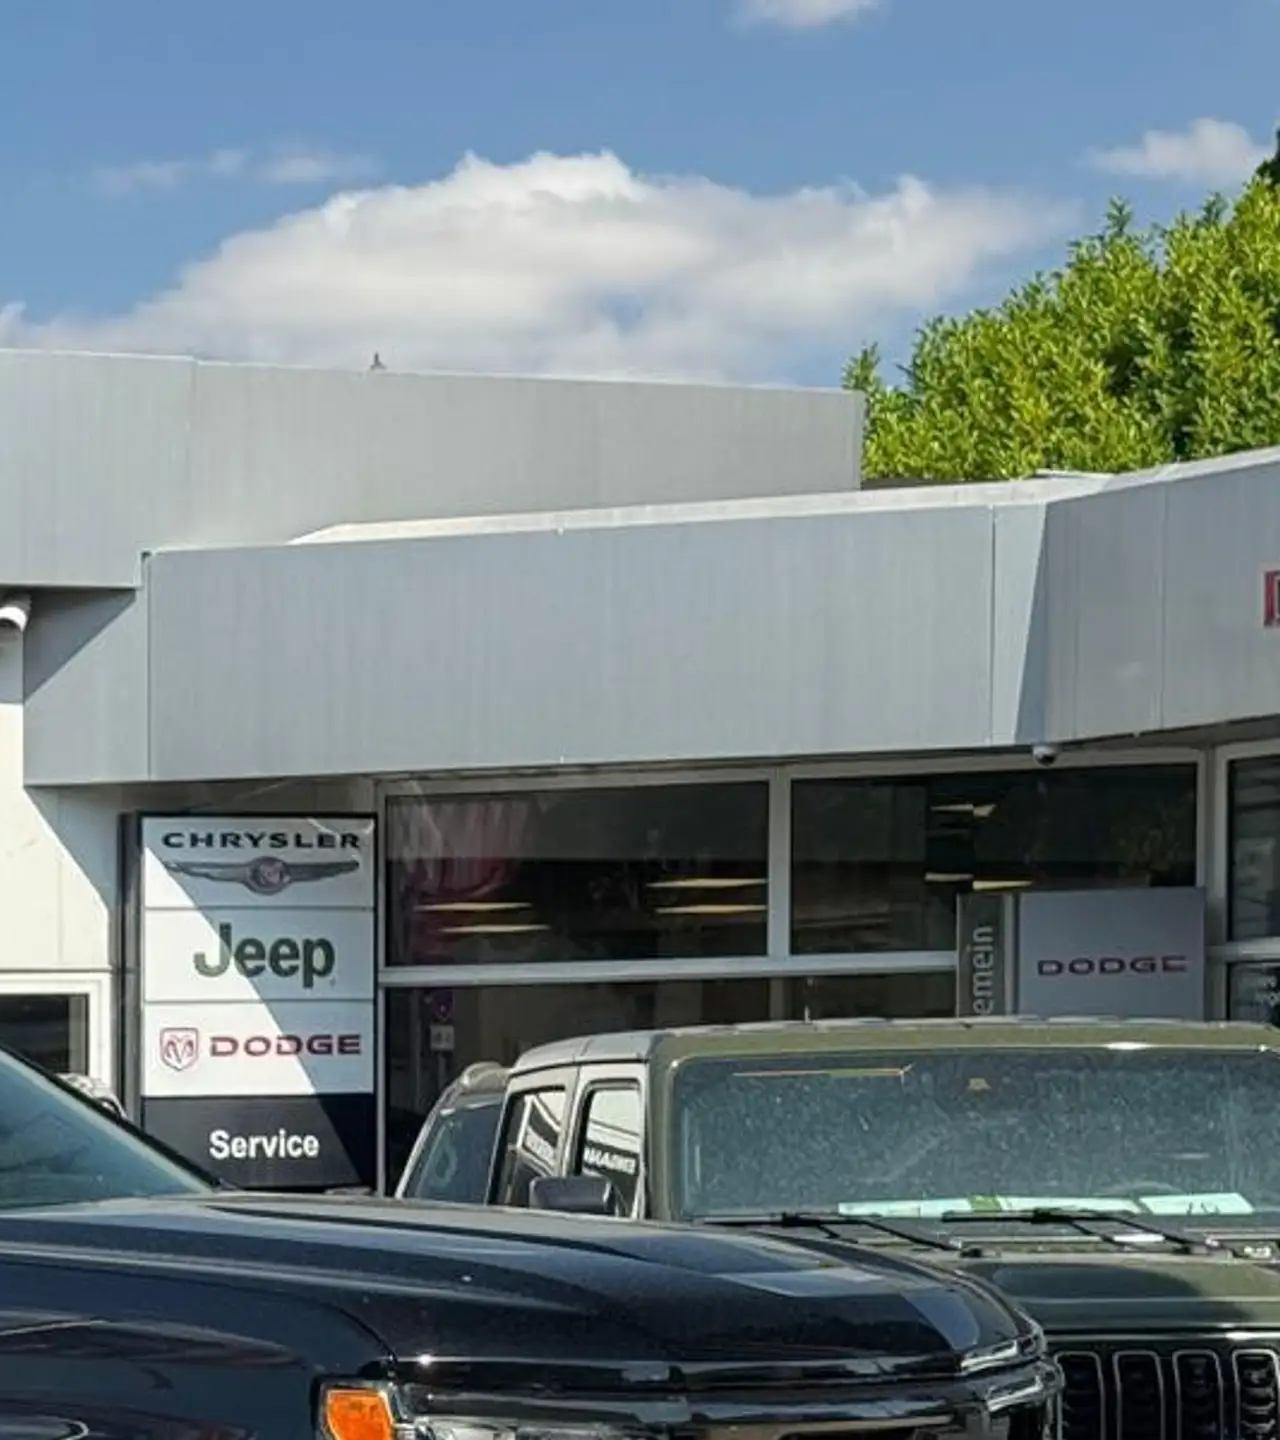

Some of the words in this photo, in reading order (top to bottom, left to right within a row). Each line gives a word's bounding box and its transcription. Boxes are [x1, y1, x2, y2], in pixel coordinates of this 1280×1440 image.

[162, 832, 361, 848] CHRYSLER
[194, 922, 336, 989] Jeep
[1038, 955, 1189, 977] DODGE
[209, 1034, 362, 1057] DODGE
[208, 1128, 321, 1160] Service
